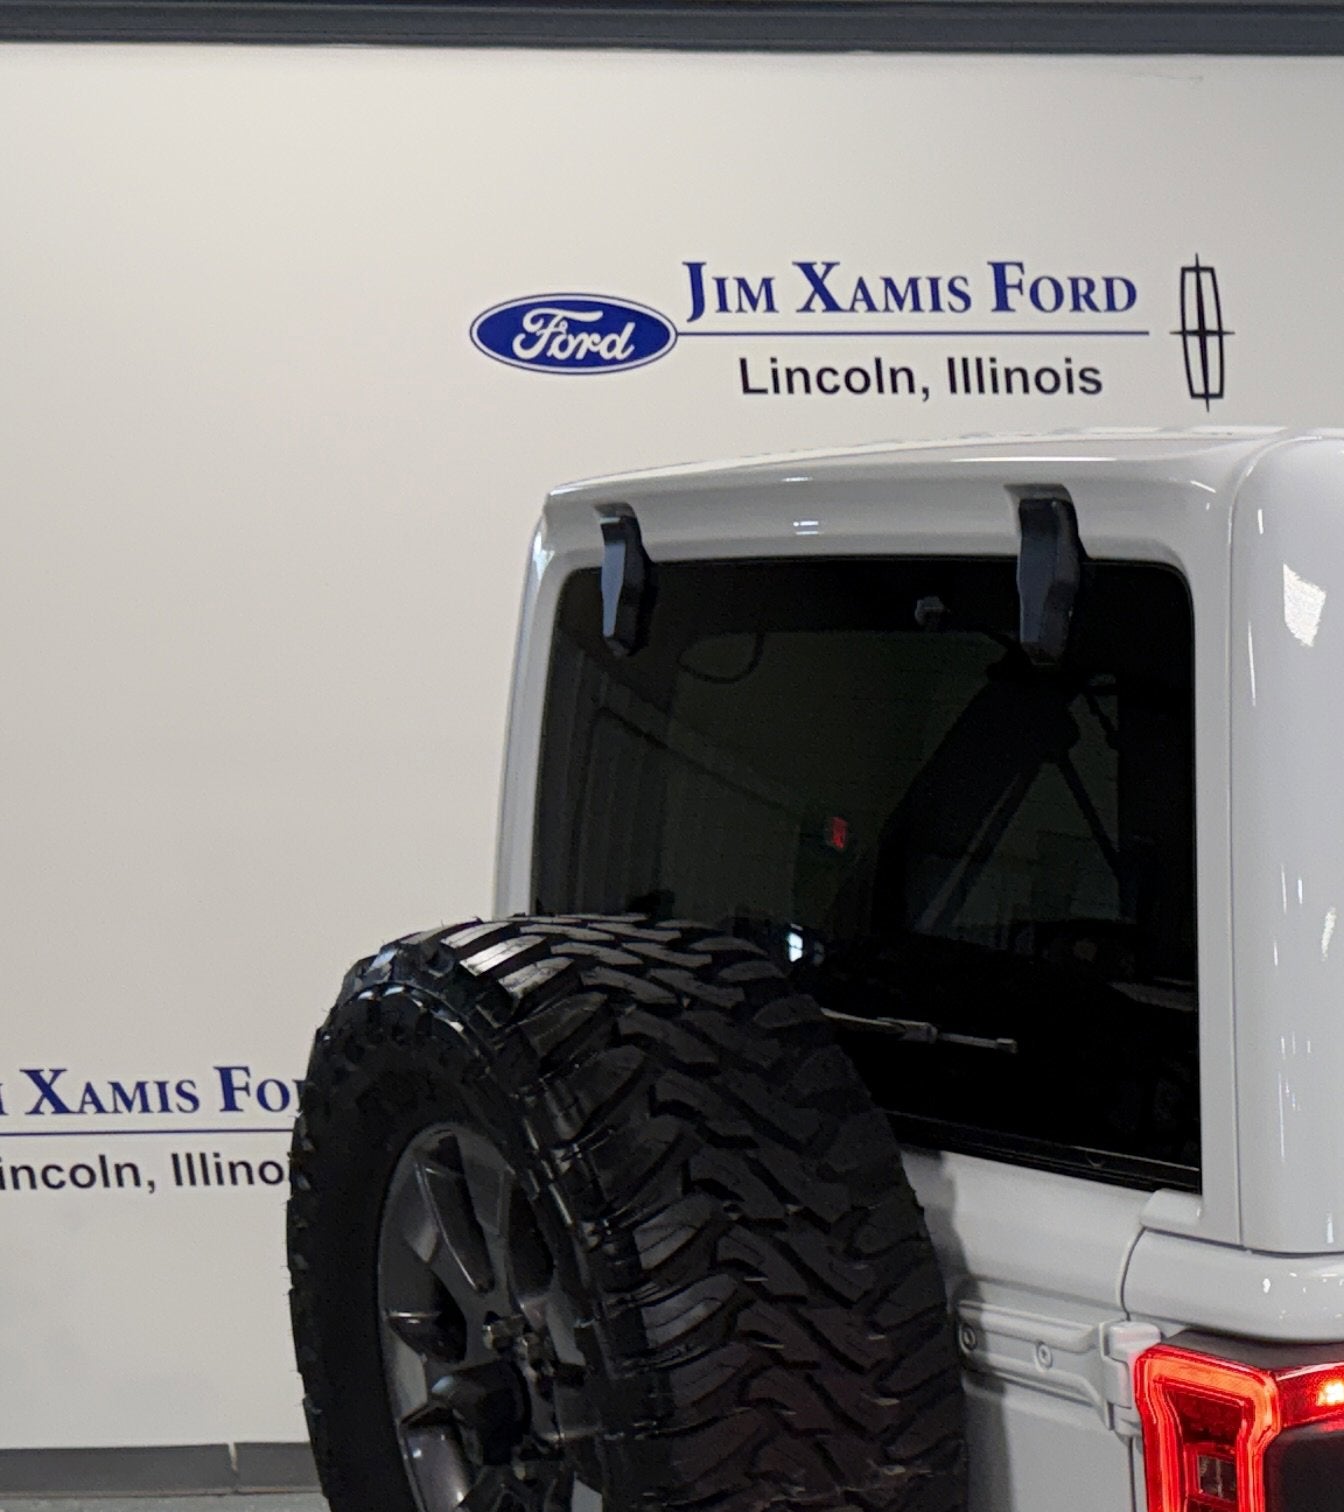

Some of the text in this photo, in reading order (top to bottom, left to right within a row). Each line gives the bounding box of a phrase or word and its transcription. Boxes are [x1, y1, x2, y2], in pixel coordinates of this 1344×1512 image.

[682, 261, 1137, 323] JIM XAMIS FORD
[512, 306, 637, 362] Ford
[739, 357, 1103, 402] Lincoln, Illinois
[19, 1068, 200, 1115] XAMIS
[214, 1066, 304, 1112] FO
[0, 1152, 285, 1194] incoln, Illino
